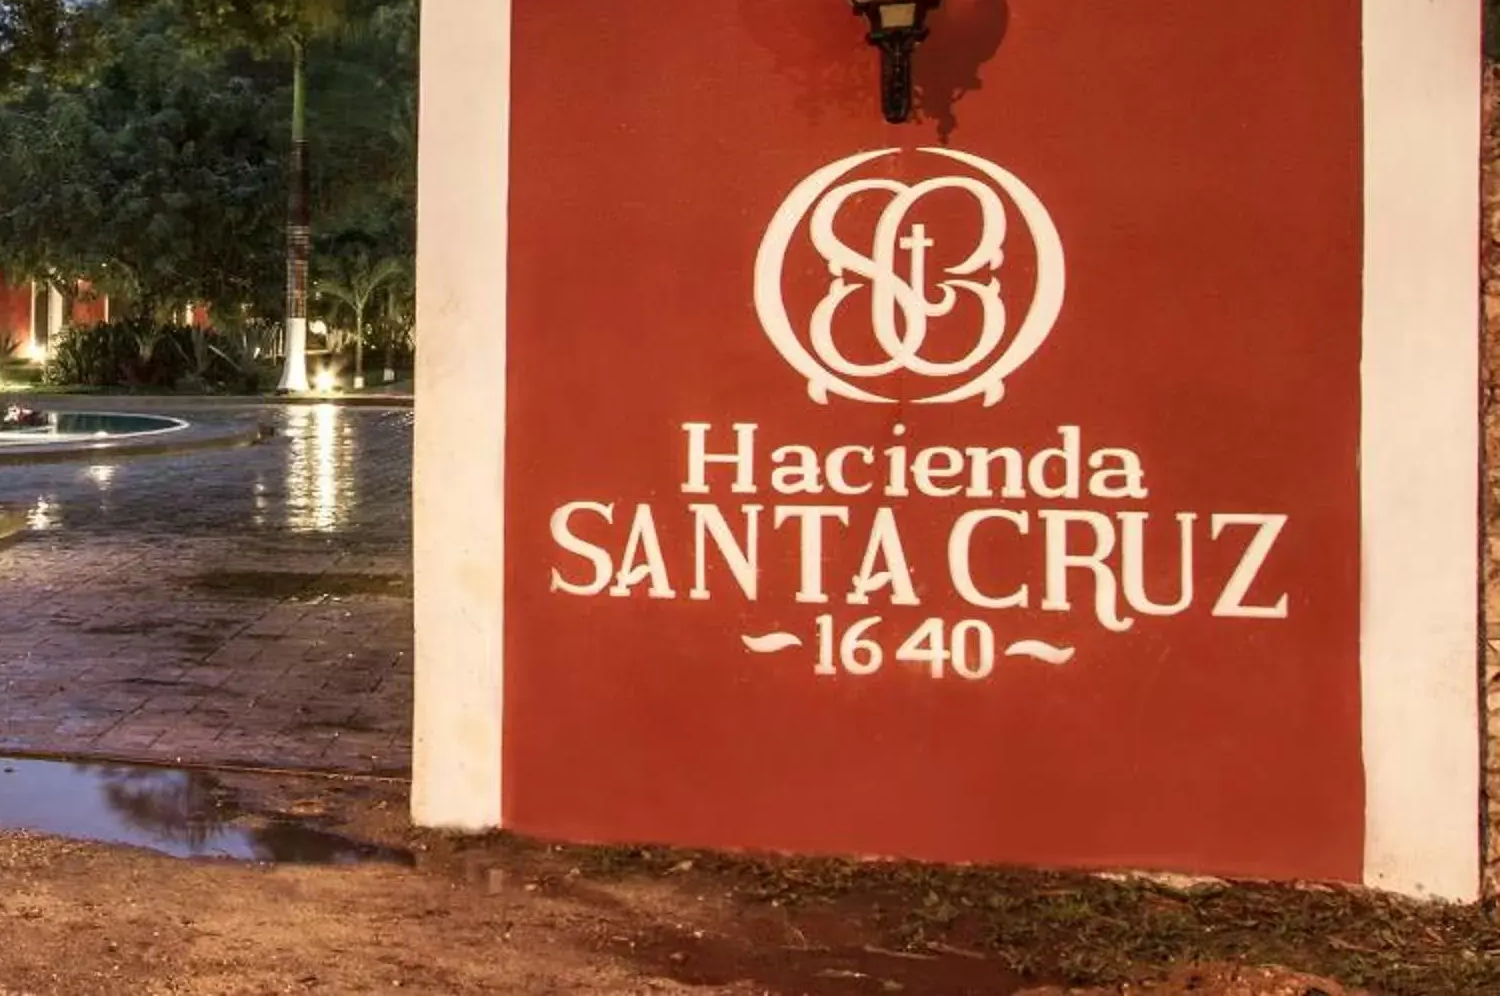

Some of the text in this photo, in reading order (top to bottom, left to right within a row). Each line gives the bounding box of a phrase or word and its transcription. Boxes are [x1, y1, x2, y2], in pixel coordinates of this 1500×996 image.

[680, 421, 1150, 500] Hacienda
[549, 500, 1289, 633] SANTA CRUZ
